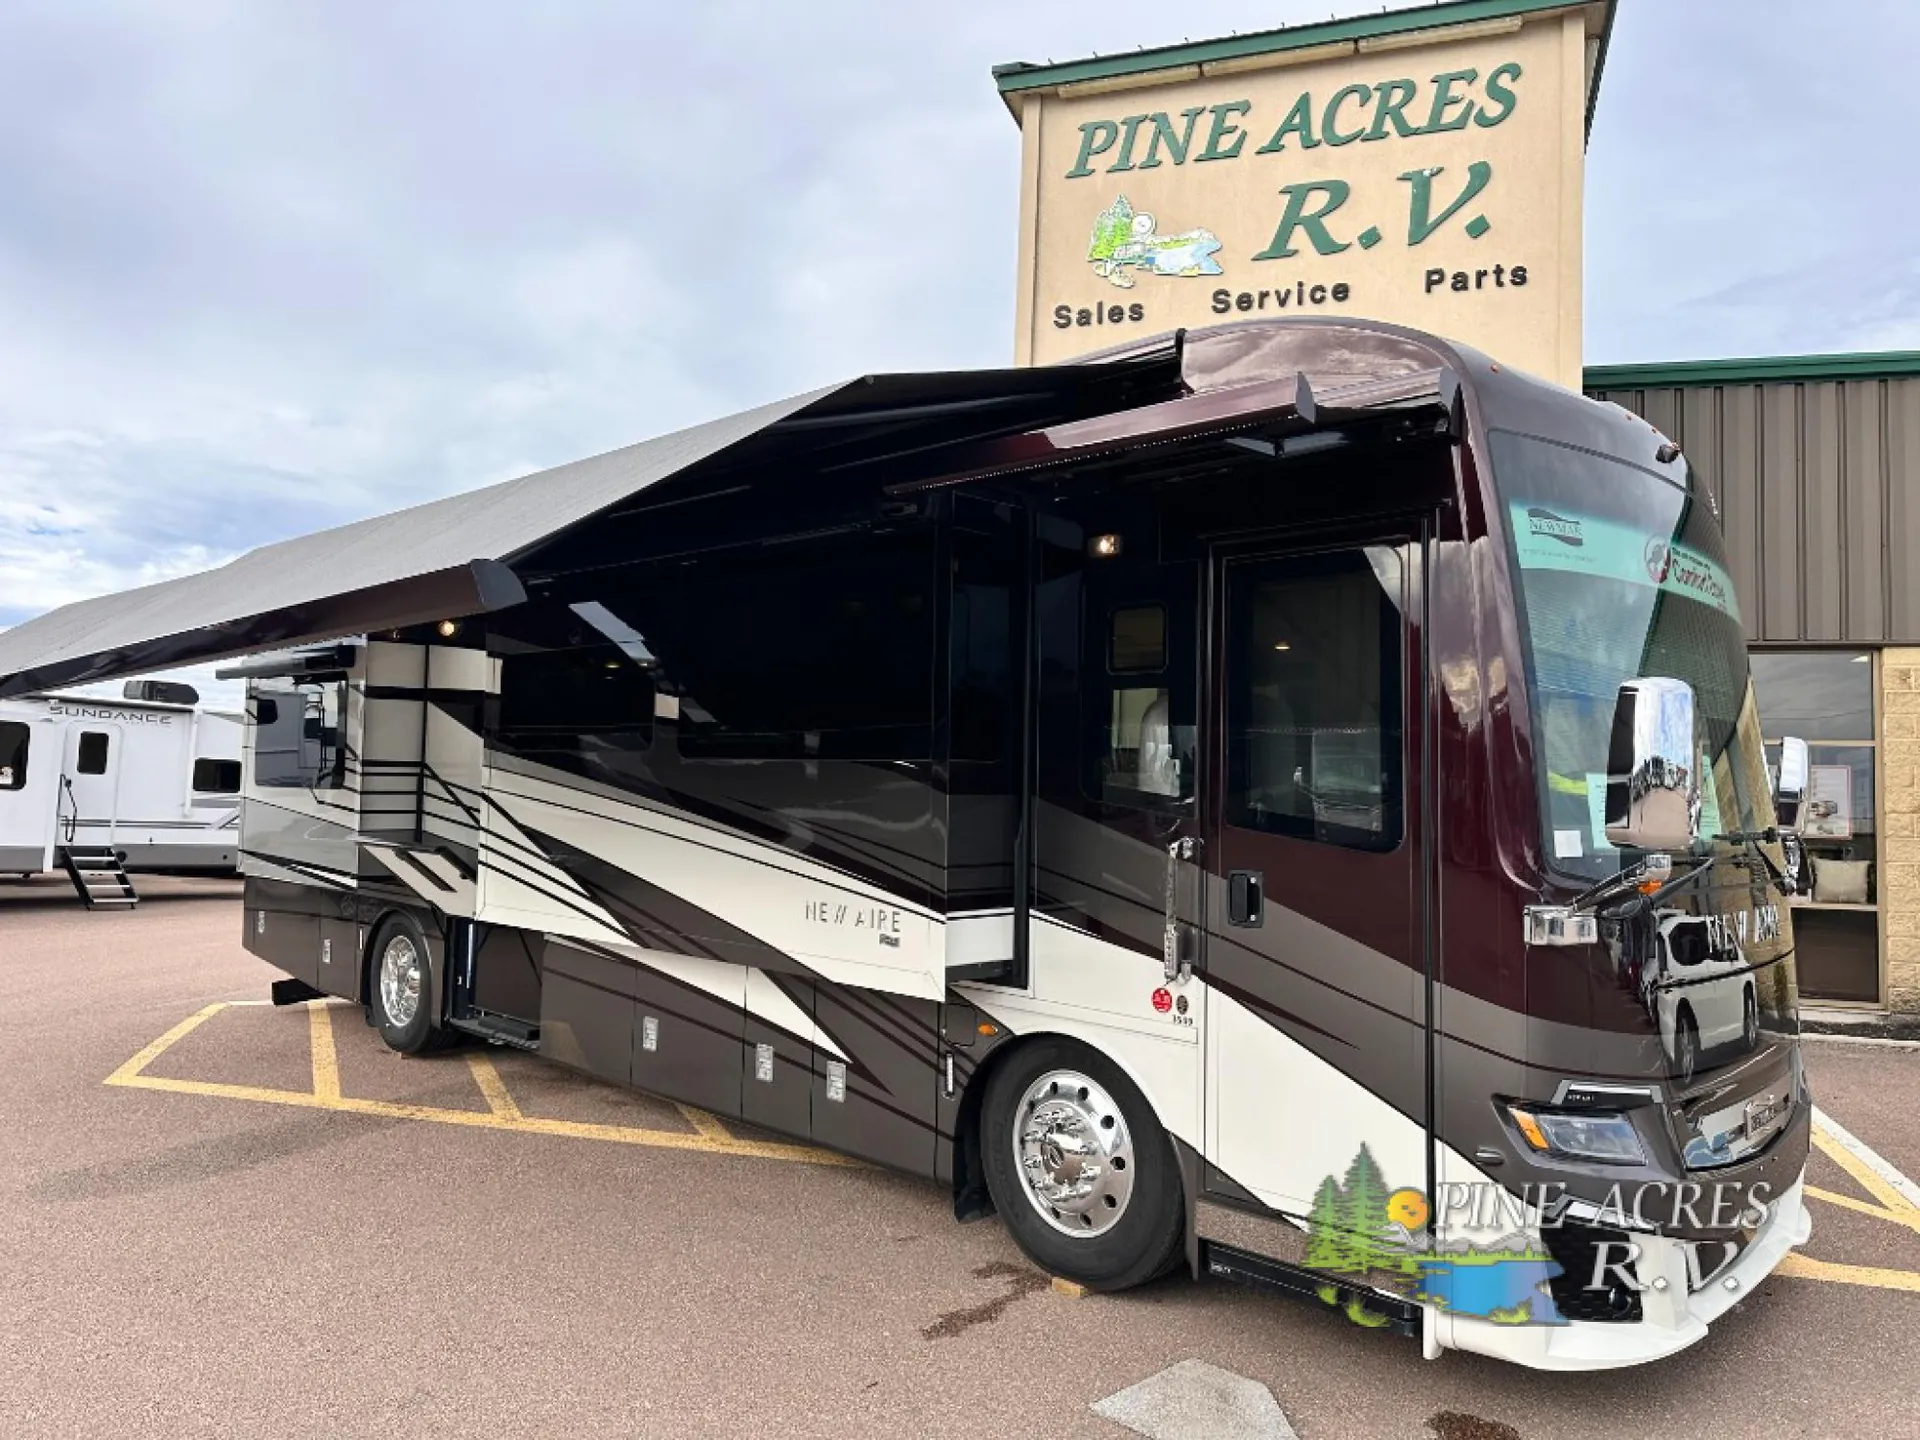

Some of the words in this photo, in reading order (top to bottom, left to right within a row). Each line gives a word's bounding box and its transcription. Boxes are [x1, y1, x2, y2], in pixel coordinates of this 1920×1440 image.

[1065, 99, 1251, 180] PINE
[1255, 63, 1523, 156] ACRES
[1251, 160, 1493, 262] R.V.
[1053, 301, 1145, 329] Sales
[1211, 280, 1351, 314] Service
[1424, 263, 1529, 294] Parts
[50, 706, 172, 724] SUNDANCE
[805, 900, 847, 925] NEW
[855, 907, 901, 933] AIRE
